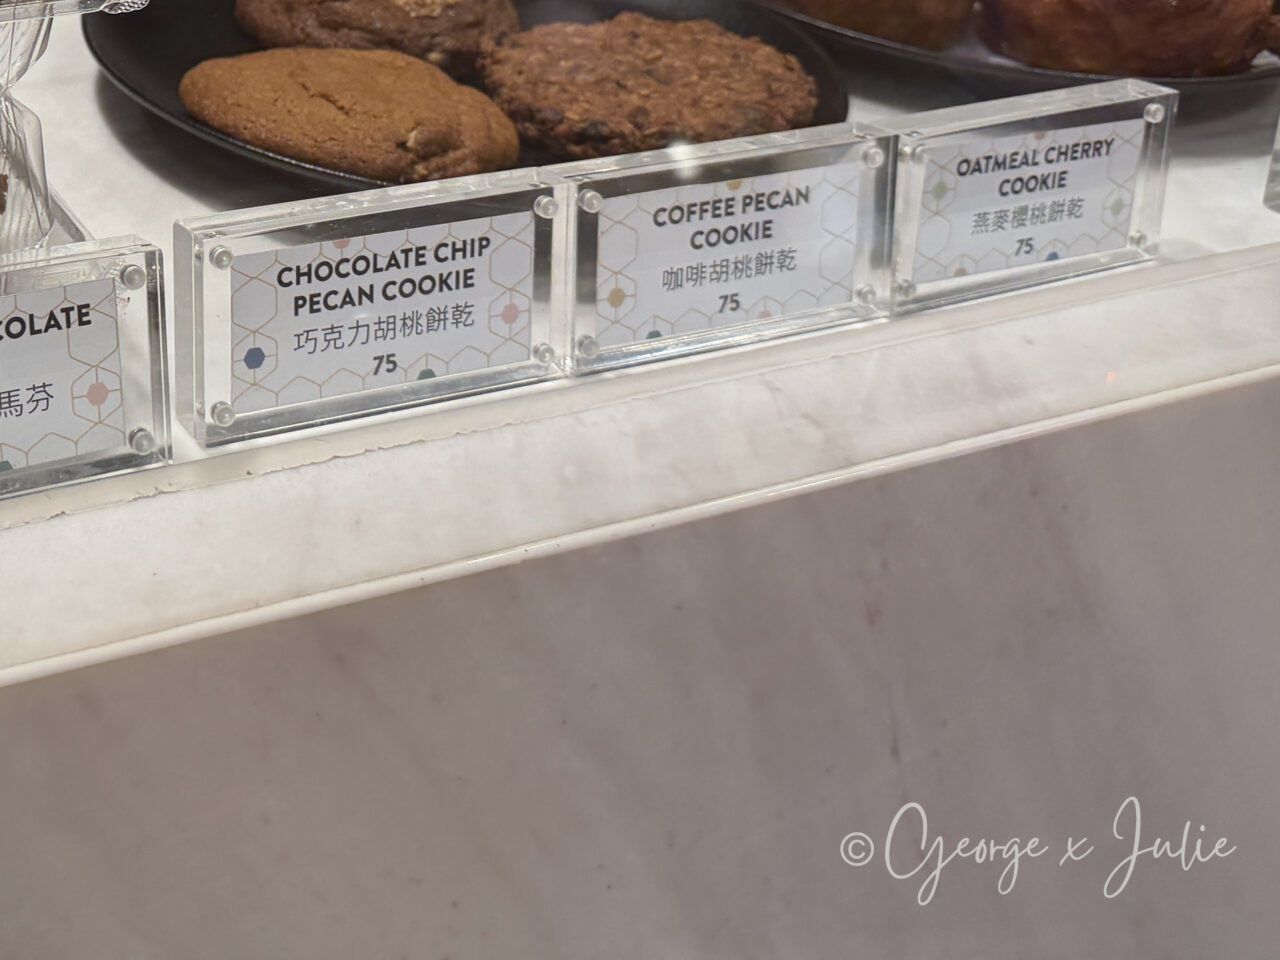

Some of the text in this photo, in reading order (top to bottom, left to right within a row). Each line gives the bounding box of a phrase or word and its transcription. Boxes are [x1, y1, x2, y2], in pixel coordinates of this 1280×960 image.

[956, 138, 1115, 177] OATMEAL CHERRY
[998, 170, 1068, 197] COOKIE
[653, 185, 810, 227] COFFEE PECAN
[971, 198, 1085, 235] 燕麥櫻桃餅乾
[690, 219, 774, 250] COOKIE
[1016, 237, 1034, 257] 75
[277, 235, 492, 288] CHOCOLATE CHIP
[662, 246, 798, 292] 咖啡胡桃餅乾
[293, 267, 475, 317] PECAN COOKIE
[718, 293, 740, 314] 75
[293, 302, 475, 355] 巧克力胡桃餅乾
[372, 353, 398, 376] 75
